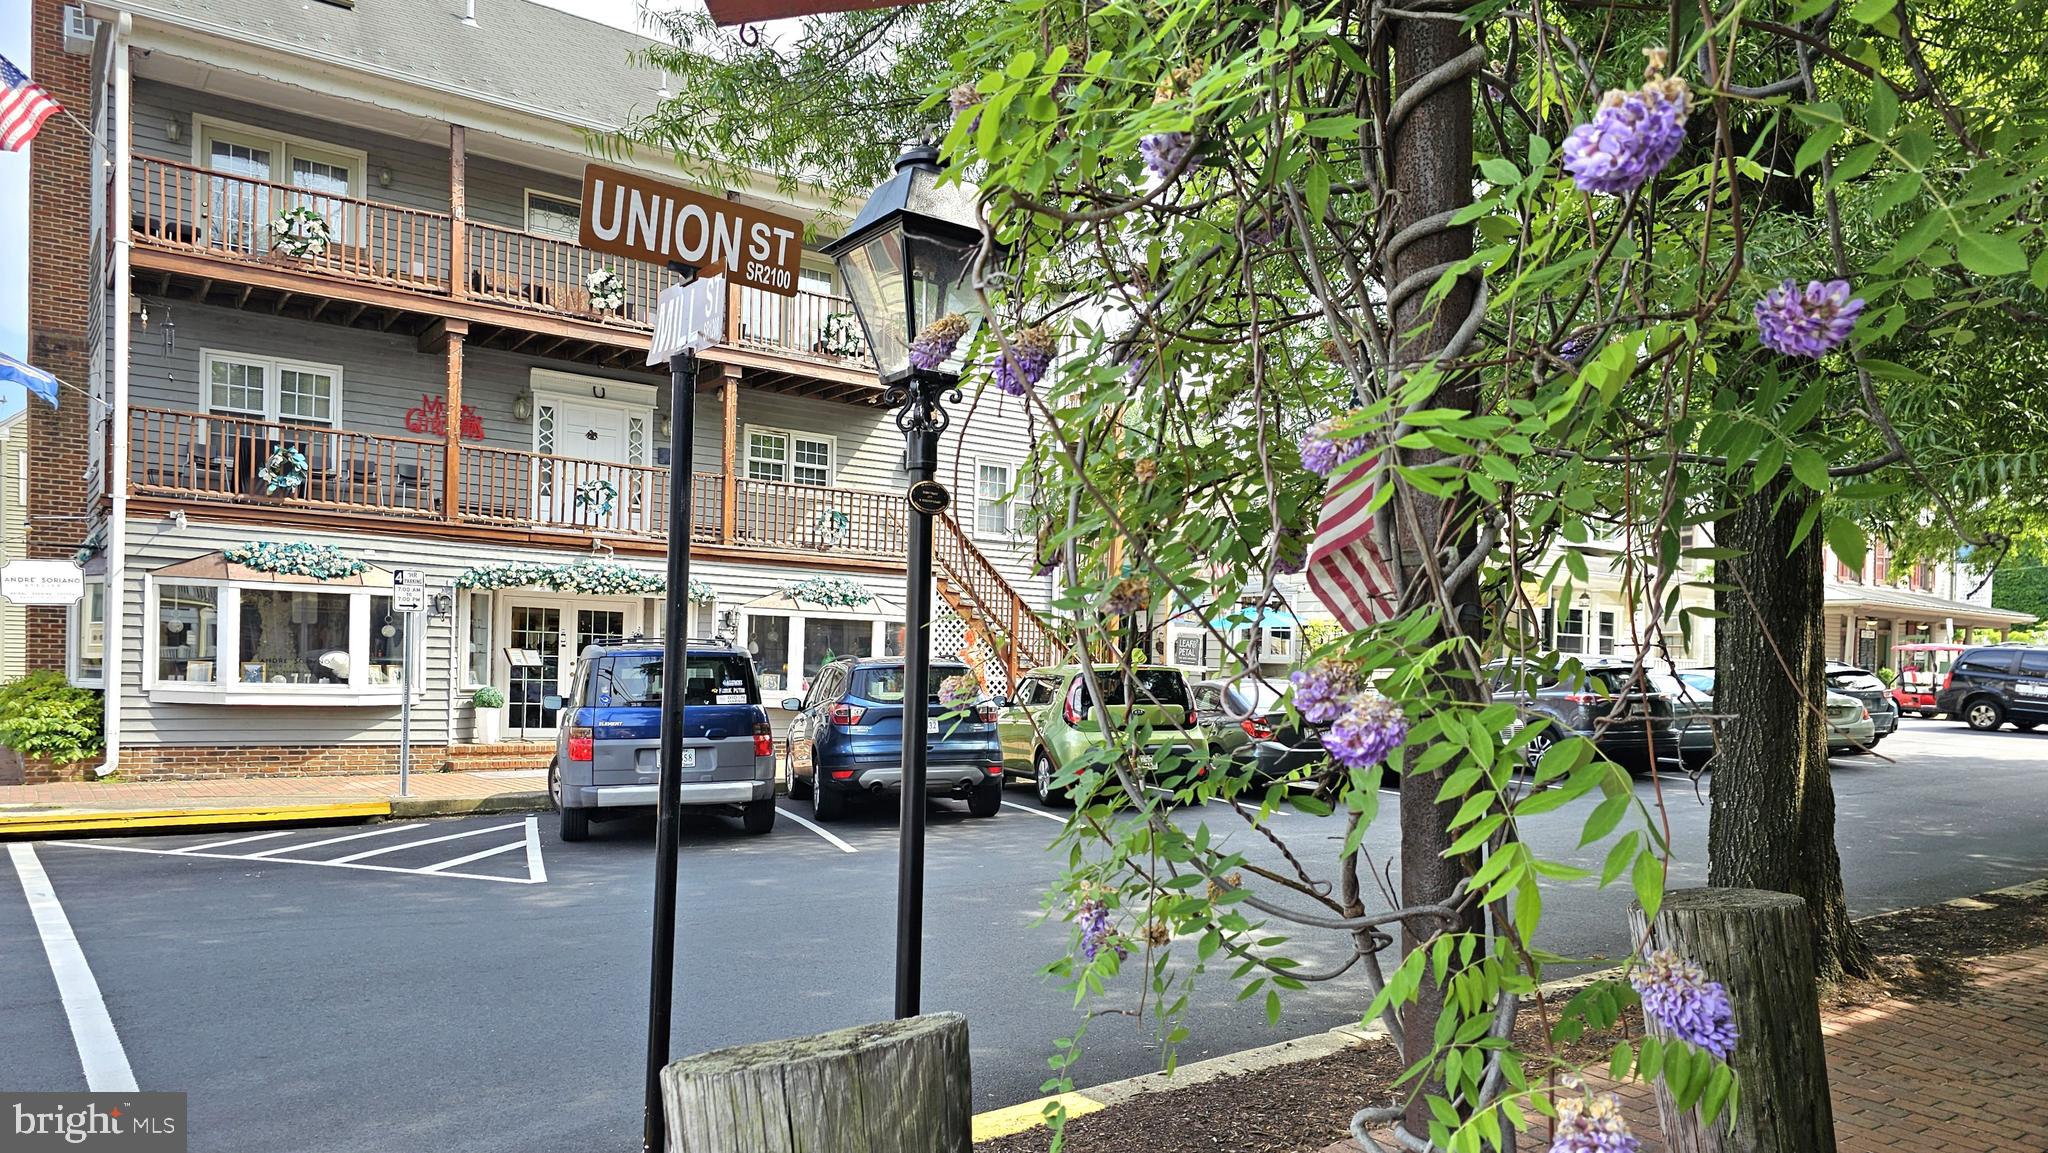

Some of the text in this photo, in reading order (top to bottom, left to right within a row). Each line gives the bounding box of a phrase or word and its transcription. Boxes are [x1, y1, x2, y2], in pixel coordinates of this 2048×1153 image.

[592, 179, 795, 273] UNION ST
[746, 261, 791, 290] SR2100
[652, 287, 699, 354] MILL
[704, 273, 723, 318] ST
[395, 571, 403, 584] 4
[1179, 648, 1196, 657] PETAL
